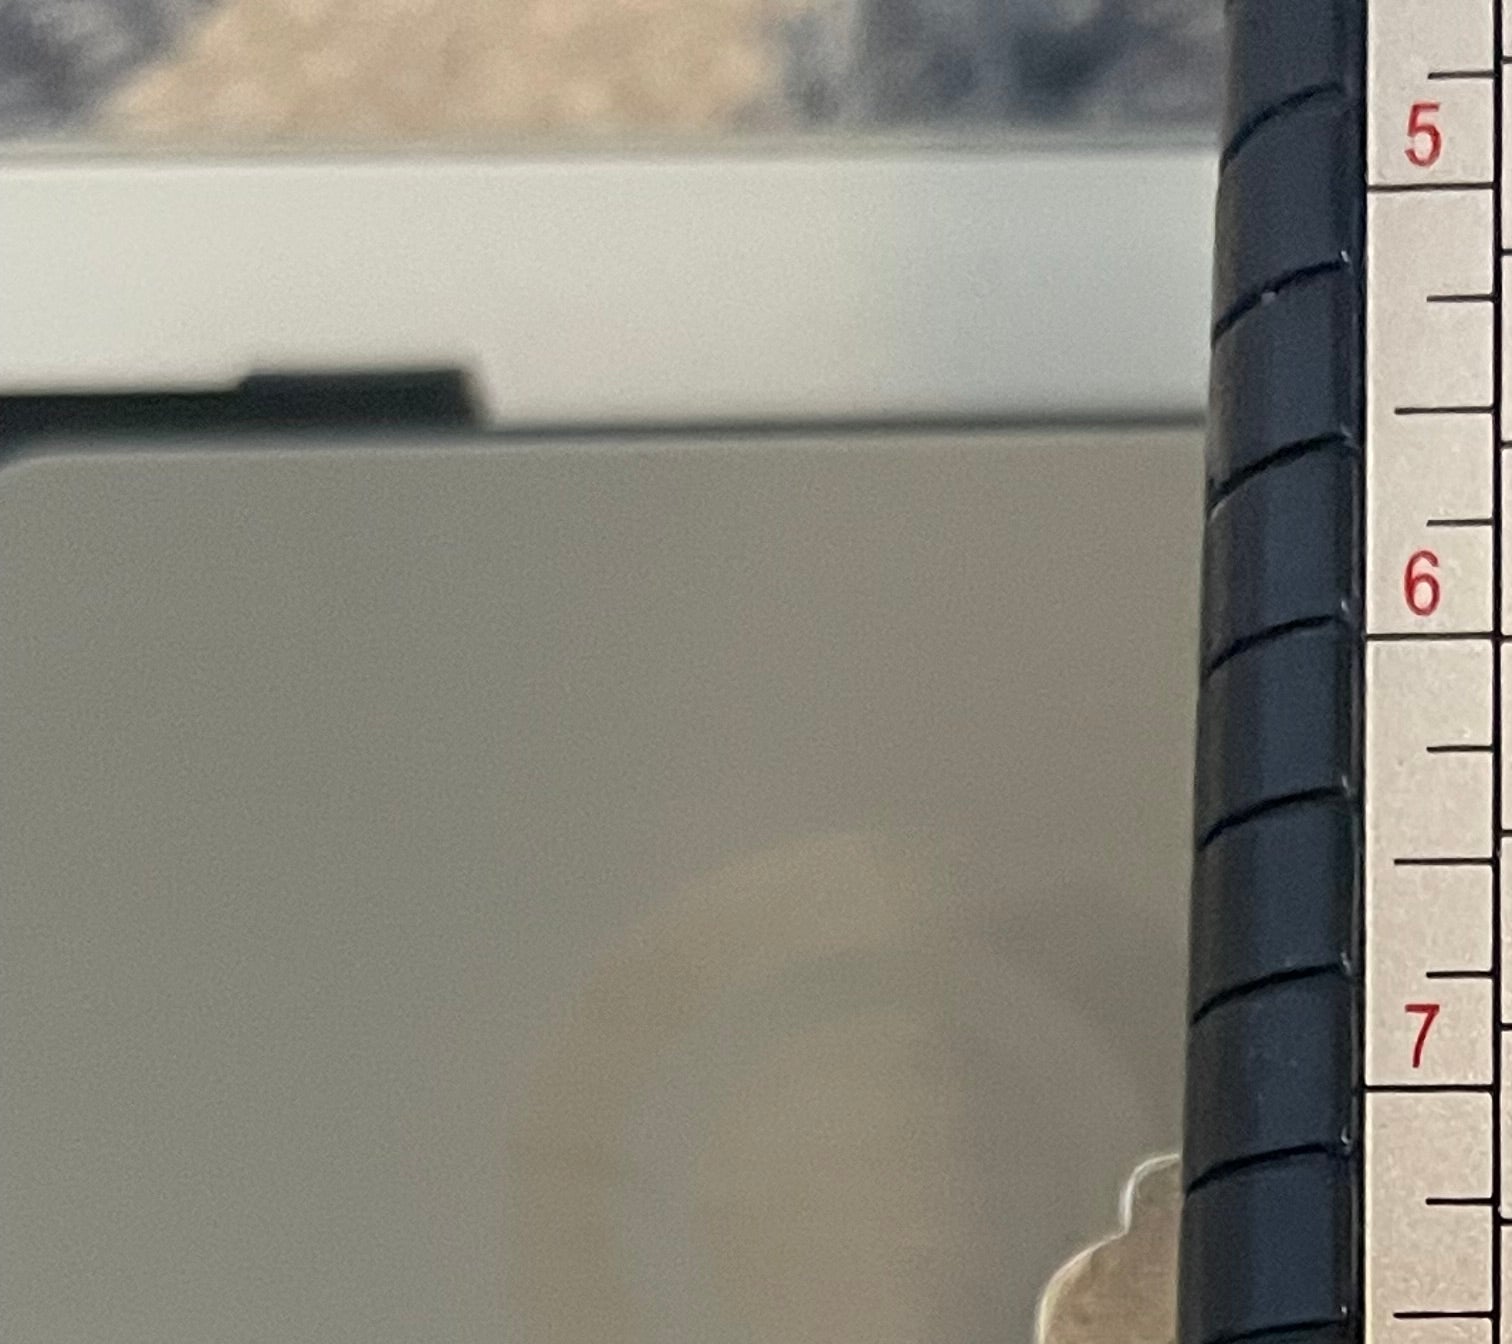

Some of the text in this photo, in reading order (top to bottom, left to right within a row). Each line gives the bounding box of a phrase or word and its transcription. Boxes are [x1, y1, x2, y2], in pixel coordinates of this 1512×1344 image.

[1404, 99, 1444, 168] 5
[1401, 547, 1443, 618] 6
[1403, 1000, 1442, 1069] 7
